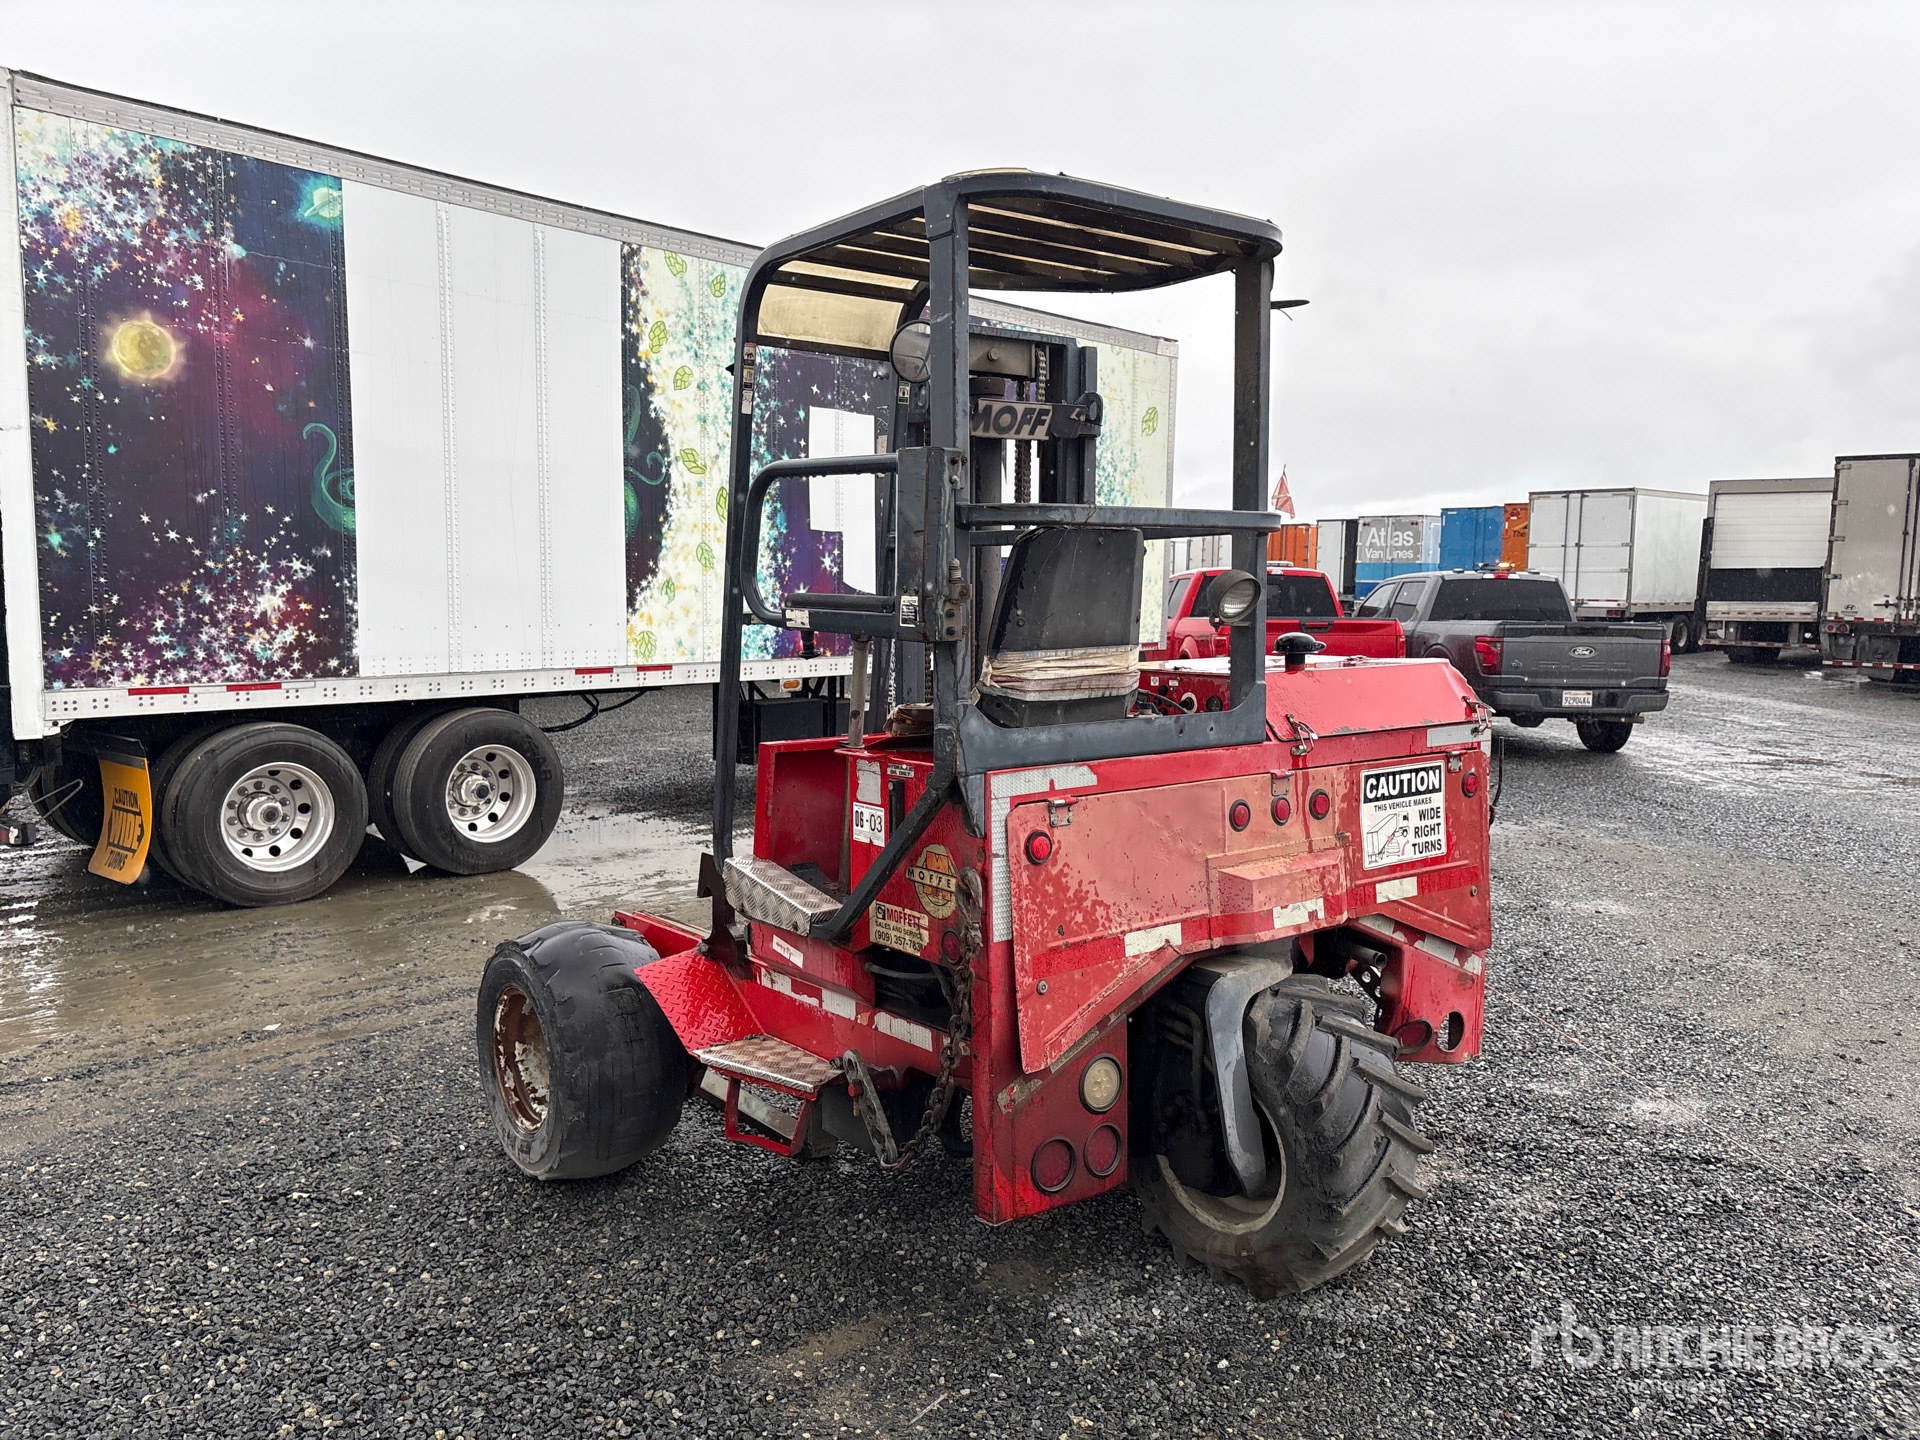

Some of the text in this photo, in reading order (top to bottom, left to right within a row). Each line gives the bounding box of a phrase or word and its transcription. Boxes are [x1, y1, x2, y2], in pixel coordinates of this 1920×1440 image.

[1365, 526, 1414, 547] Atlas
[1365, 547, 1414, 560] Van Lines
[1366, 769, 1440, 799] CAUTION
[114, 787, 139, 809] CAUTION
[1374, 797, 1432, 813] THIS VEHICLE MAKES
[1418, 807, 1441, 821] WIDE
[108, 809, 143, 850] WIDE
[1414, 823, 1441, 839] RIGHT
[1412, 839, 1442, 856] TURNS
[104, 850, 129, 871] TURNS
[887, 907, 921, 929] MOFFETT
[875, 920, 891, 931] SALES
[892, 925, 903, 934] AND
[875, 930, 893, 946] (909)
